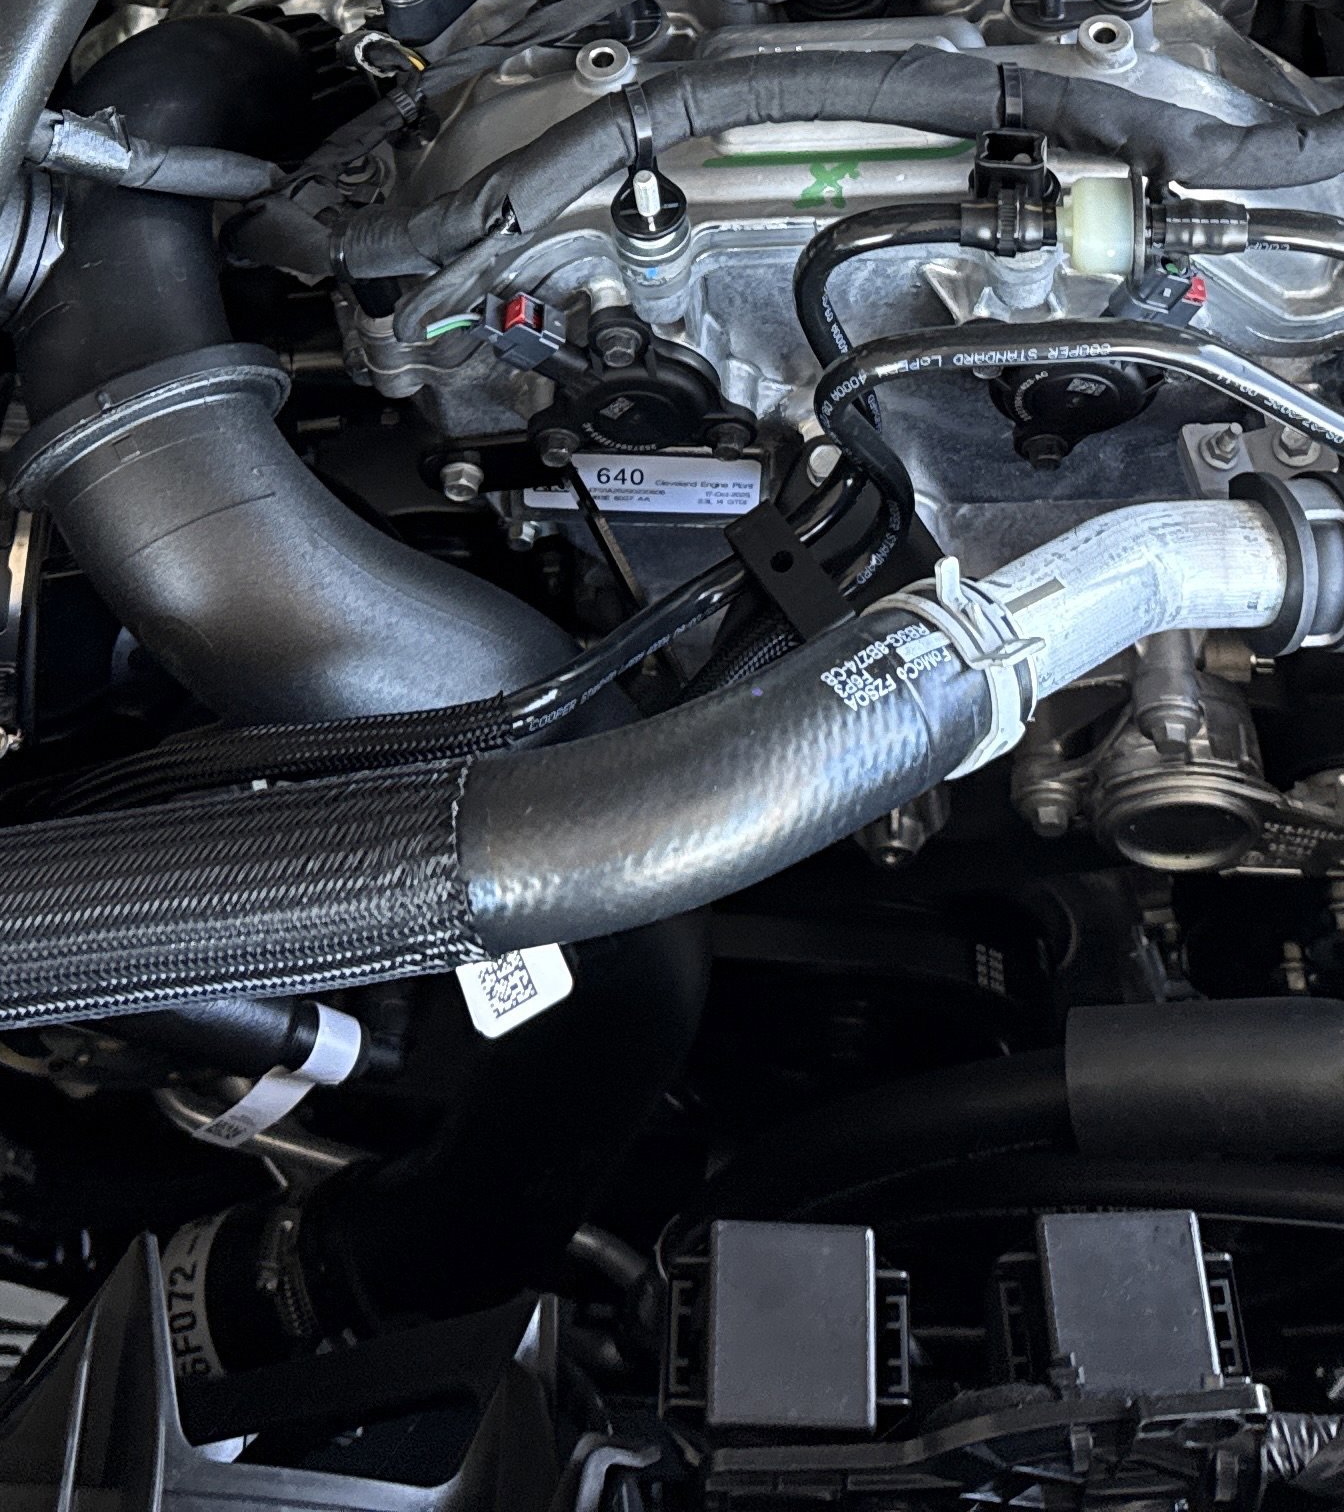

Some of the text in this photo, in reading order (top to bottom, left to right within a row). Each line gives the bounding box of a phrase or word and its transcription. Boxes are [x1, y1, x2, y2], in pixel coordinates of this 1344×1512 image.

[952, 347, 1038, 368] STANDARD
[1047, 342, 1112, 361] COOPER
[829, 368, 867, 401] 4000A
[596, 467, 646, 486] 640
[700, 481, 729, 490] Engine
[820, 622, 930, 687] RB3G-8B274-CB
[896, 646, 952, 681] FoMoCo
[833, 669, 874, 698] F6P3
[528, 698, 578, 732] COOPER
